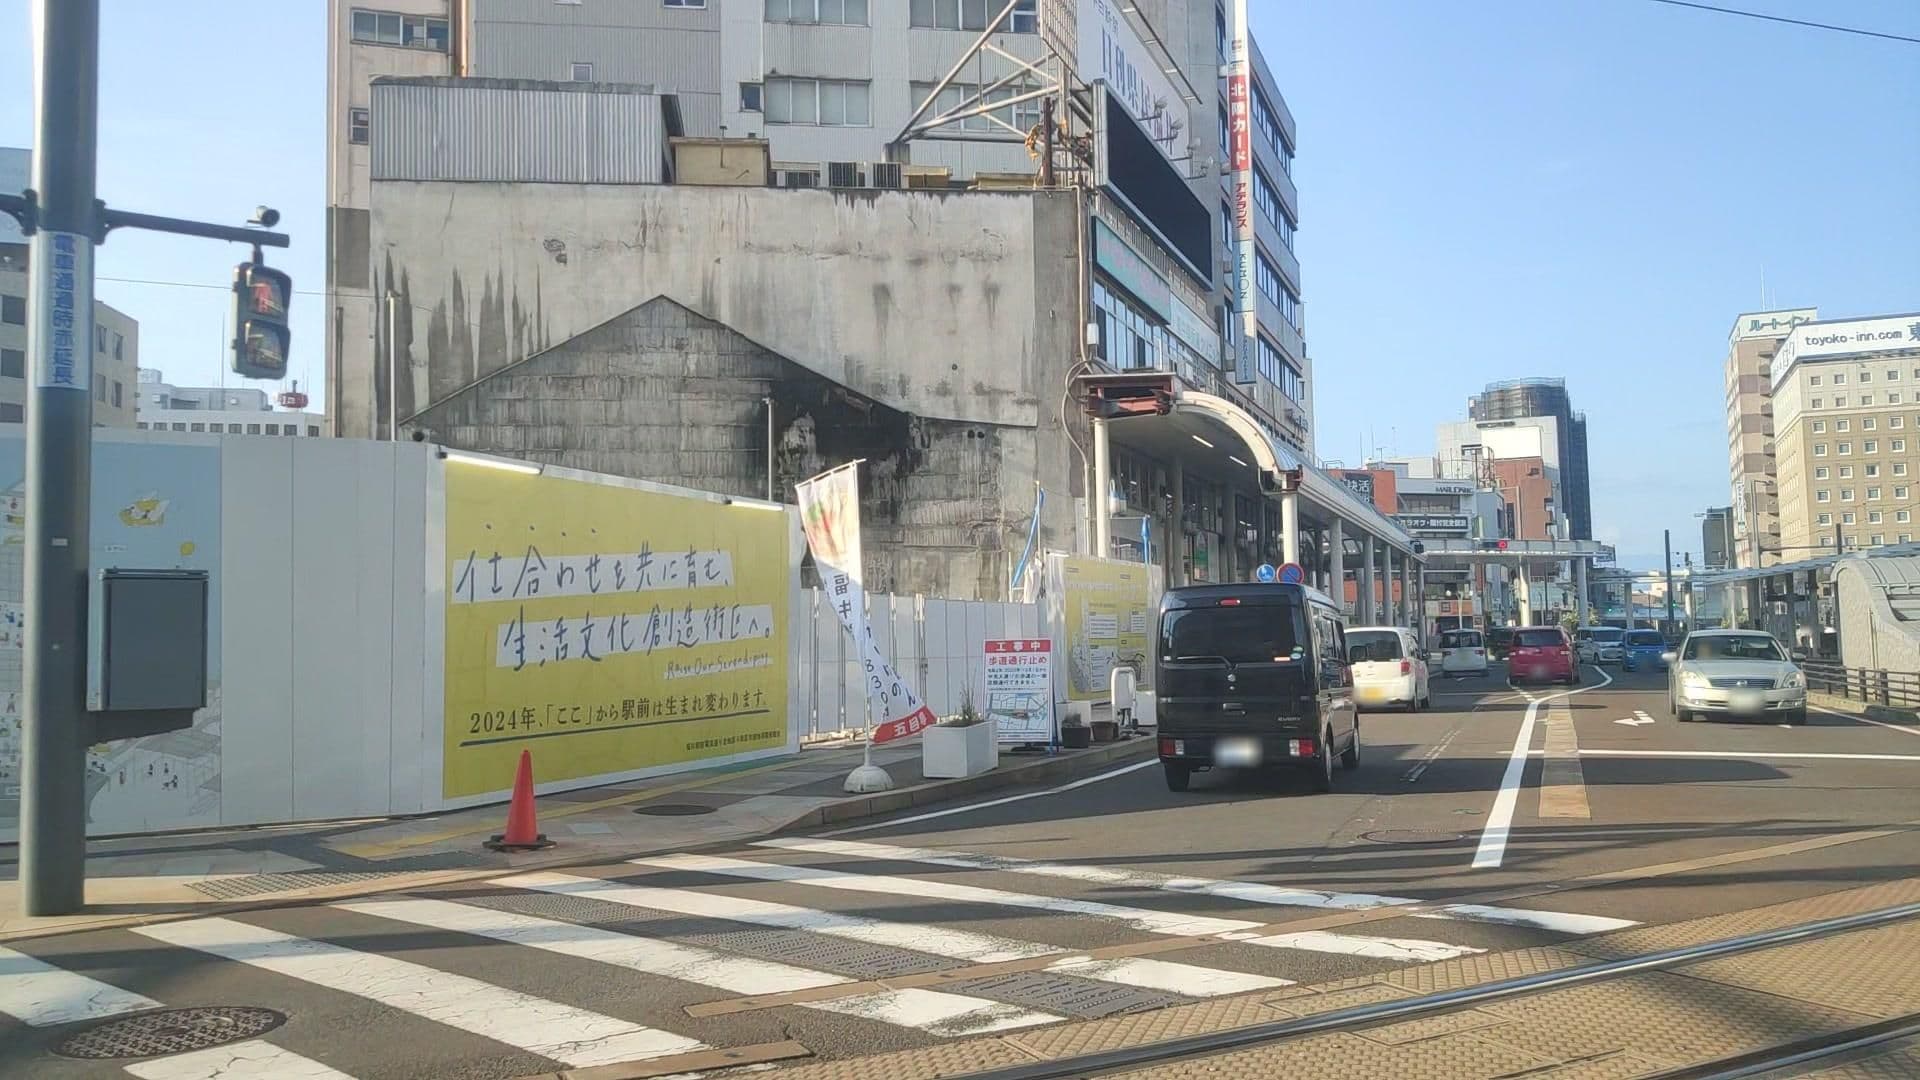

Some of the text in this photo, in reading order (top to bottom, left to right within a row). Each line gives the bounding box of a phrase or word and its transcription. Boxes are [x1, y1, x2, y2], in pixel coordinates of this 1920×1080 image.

[1235, 182, 1248, 229] アデランス
[1239, 253, 1250, 300] KUMON
[1805, 329, 1903, 347] toyoko-inn.com
[995, 641, 1041, 652] 工事中
[988, 655, 1047, 666] 歩道通行止め
